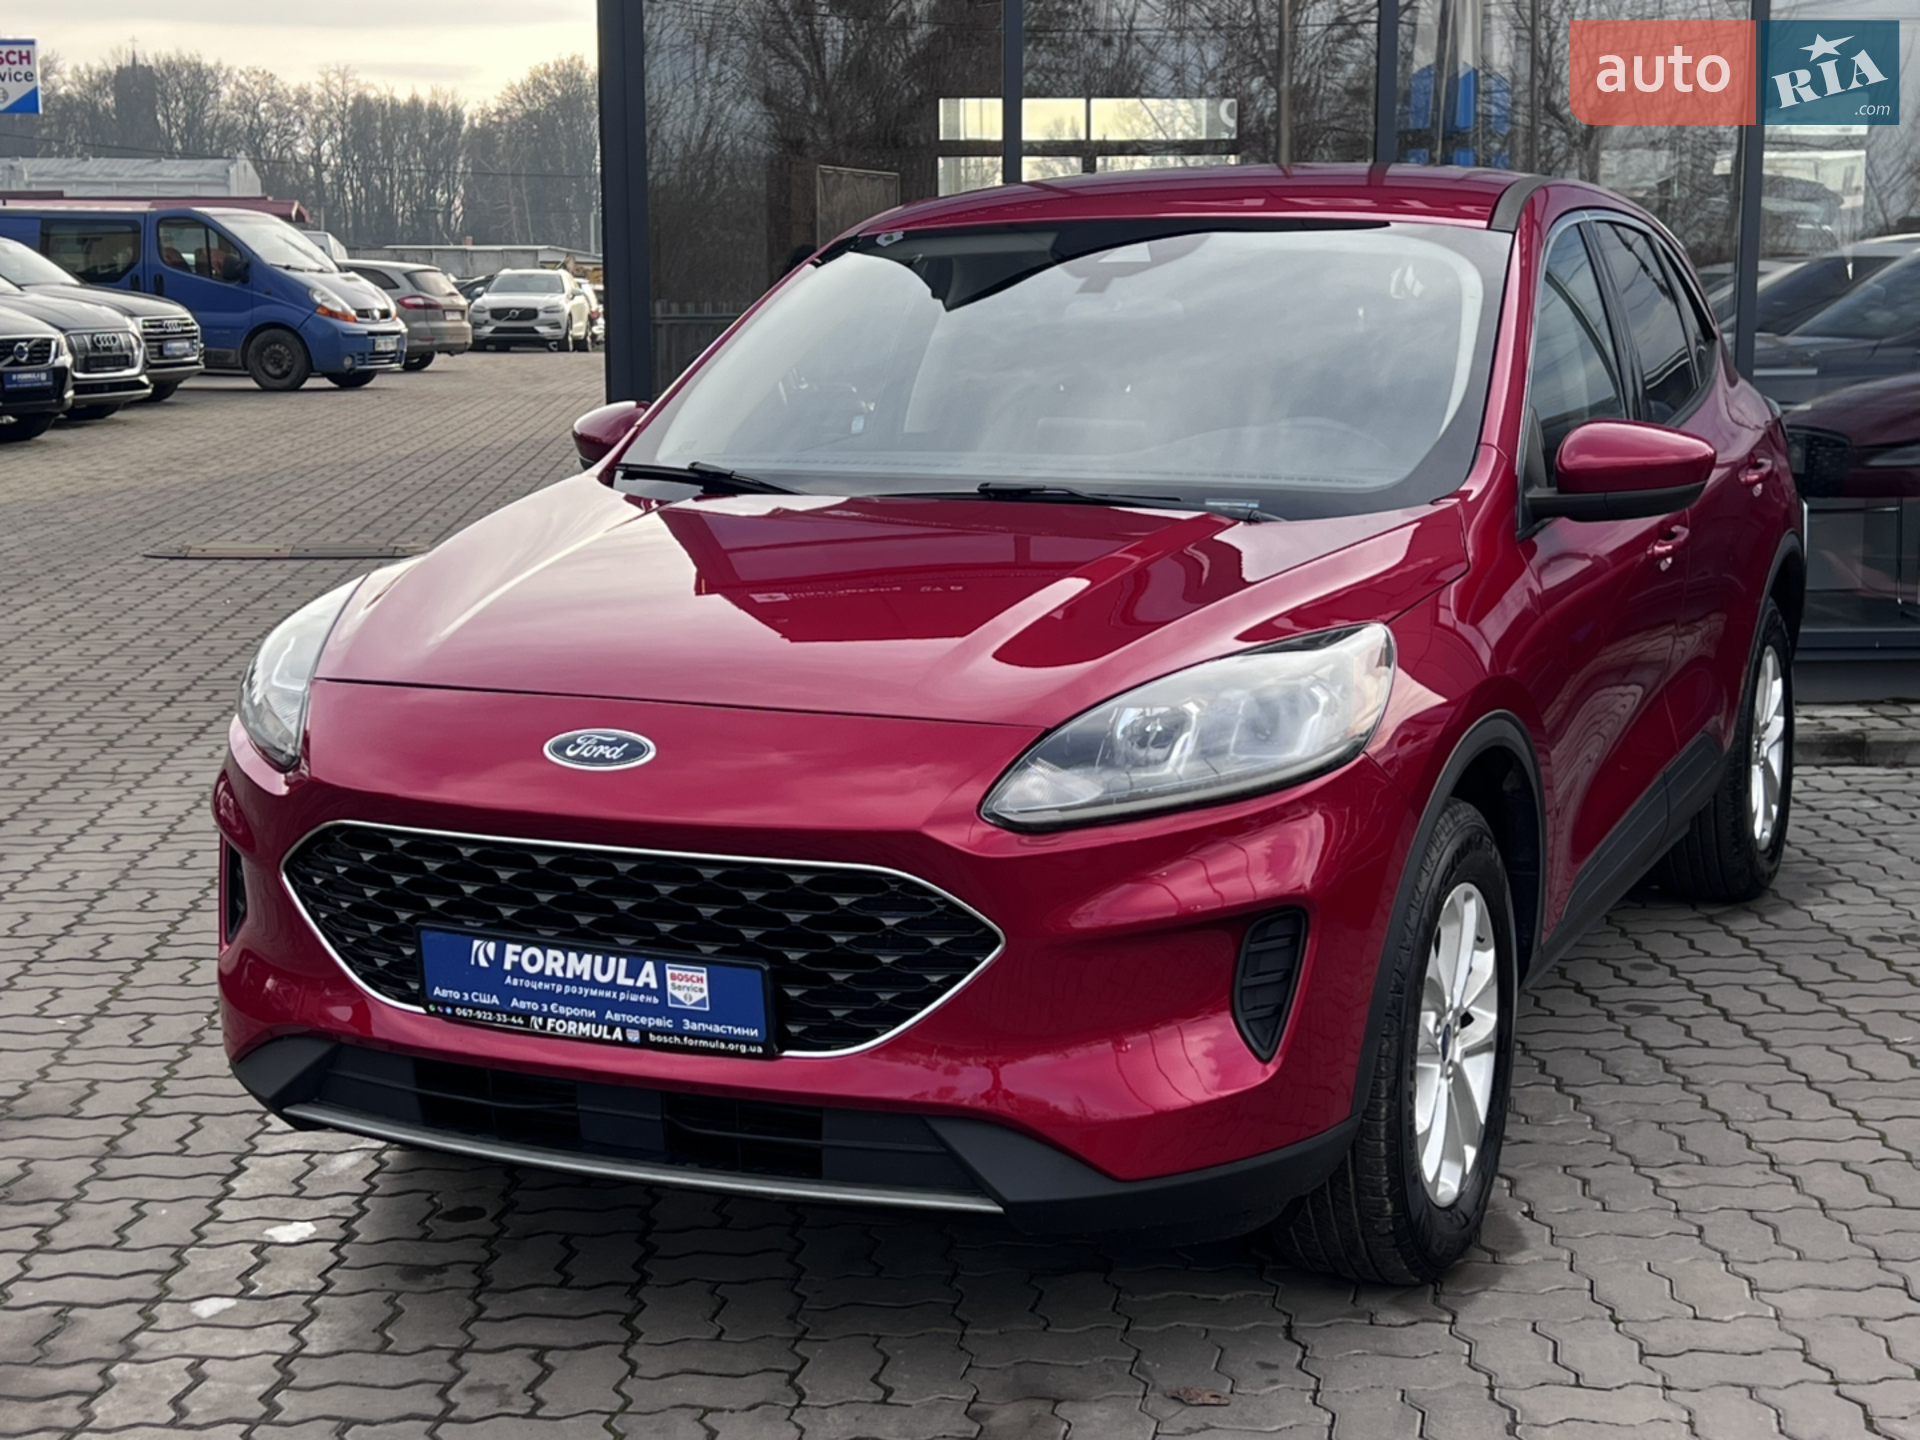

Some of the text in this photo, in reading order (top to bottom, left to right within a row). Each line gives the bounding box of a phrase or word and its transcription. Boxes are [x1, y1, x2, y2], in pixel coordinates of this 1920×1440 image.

[565, 734, 629, 760] Ford
[503, 943, 658, 989] FORMULA
[670, 972, 704, 984] BOSCH
[504, 975, 660, 1004] Автоцентр розумних рішень
[671, 982, 705, 994] Service
[433, 986, 759, 1038] Авто з США Авто з Європи Автосервіс Запчастини
[546, 1018, 623, 1041] FORMULA
[648, 1032, 763, 1054] bosch.formula.org.ua
